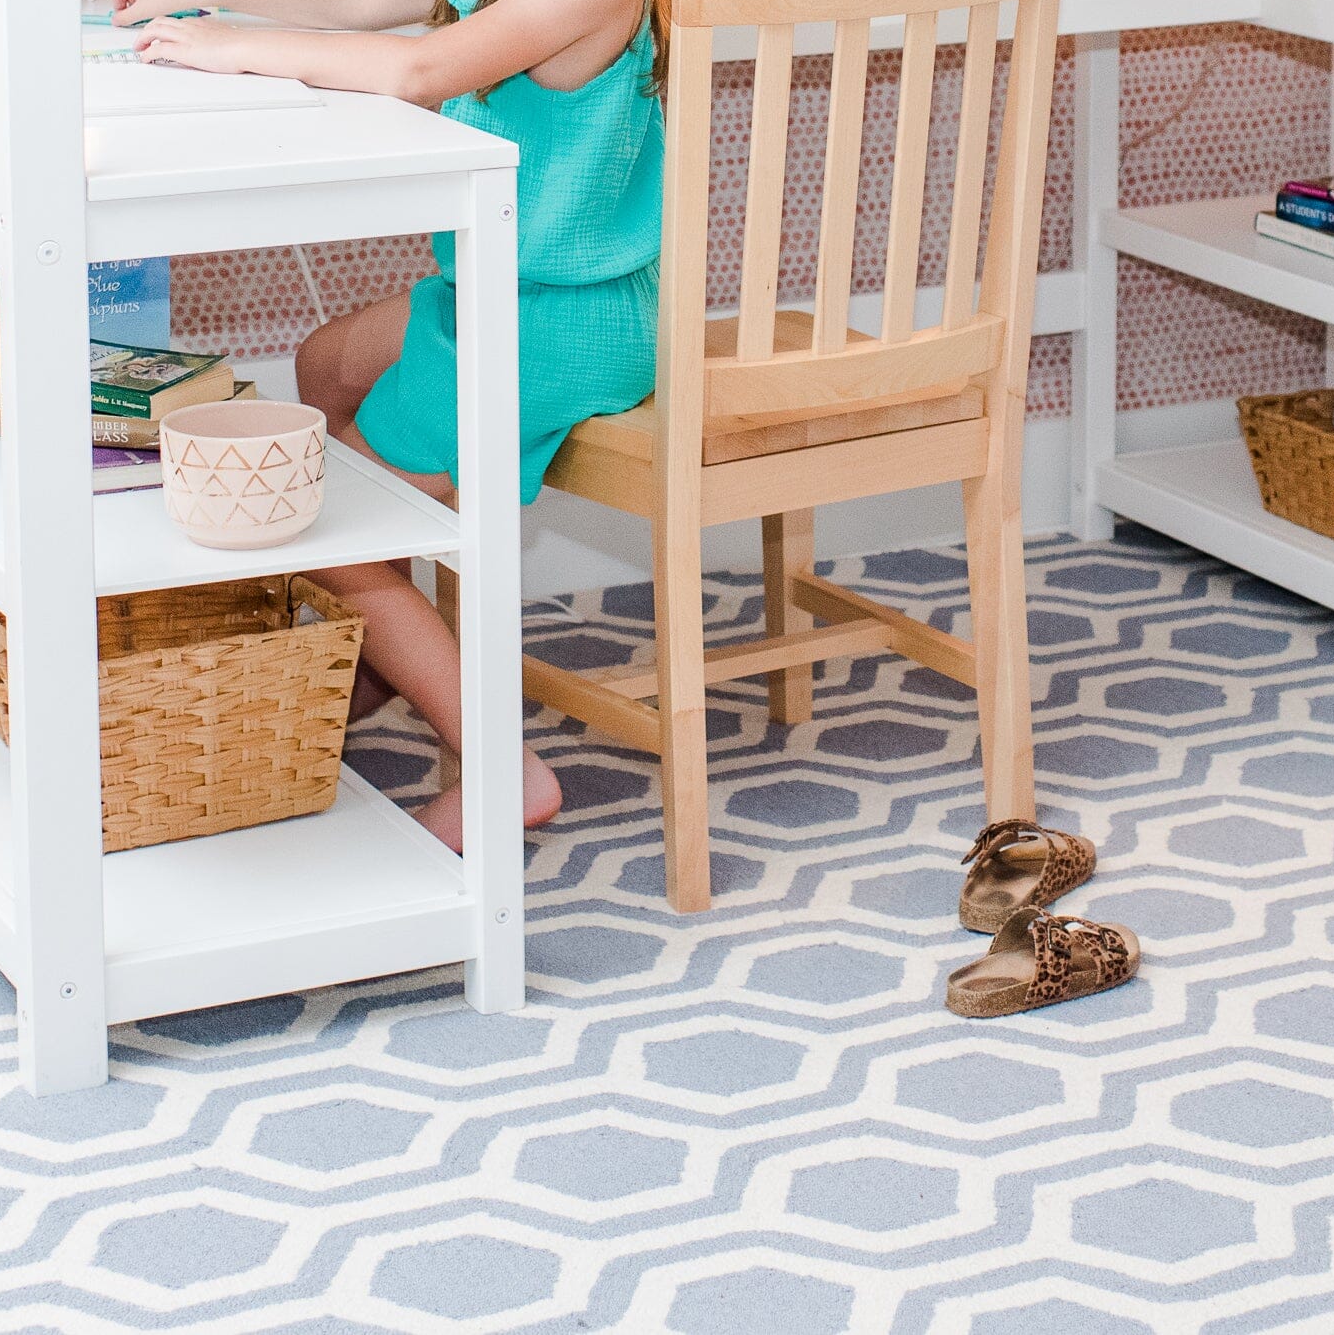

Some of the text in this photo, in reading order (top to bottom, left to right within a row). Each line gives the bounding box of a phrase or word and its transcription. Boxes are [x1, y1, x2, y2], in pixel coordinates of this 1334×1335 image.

[1279, 202, 1285, 211] A
[1285, 202, 1327, 222] STUDENT'S
[88, 275, 121, 293] Blue
[88, 297, 140, 323] olphins
[92, 420, 129, 432] MBER
[93, 430, 130, 443] LASS
